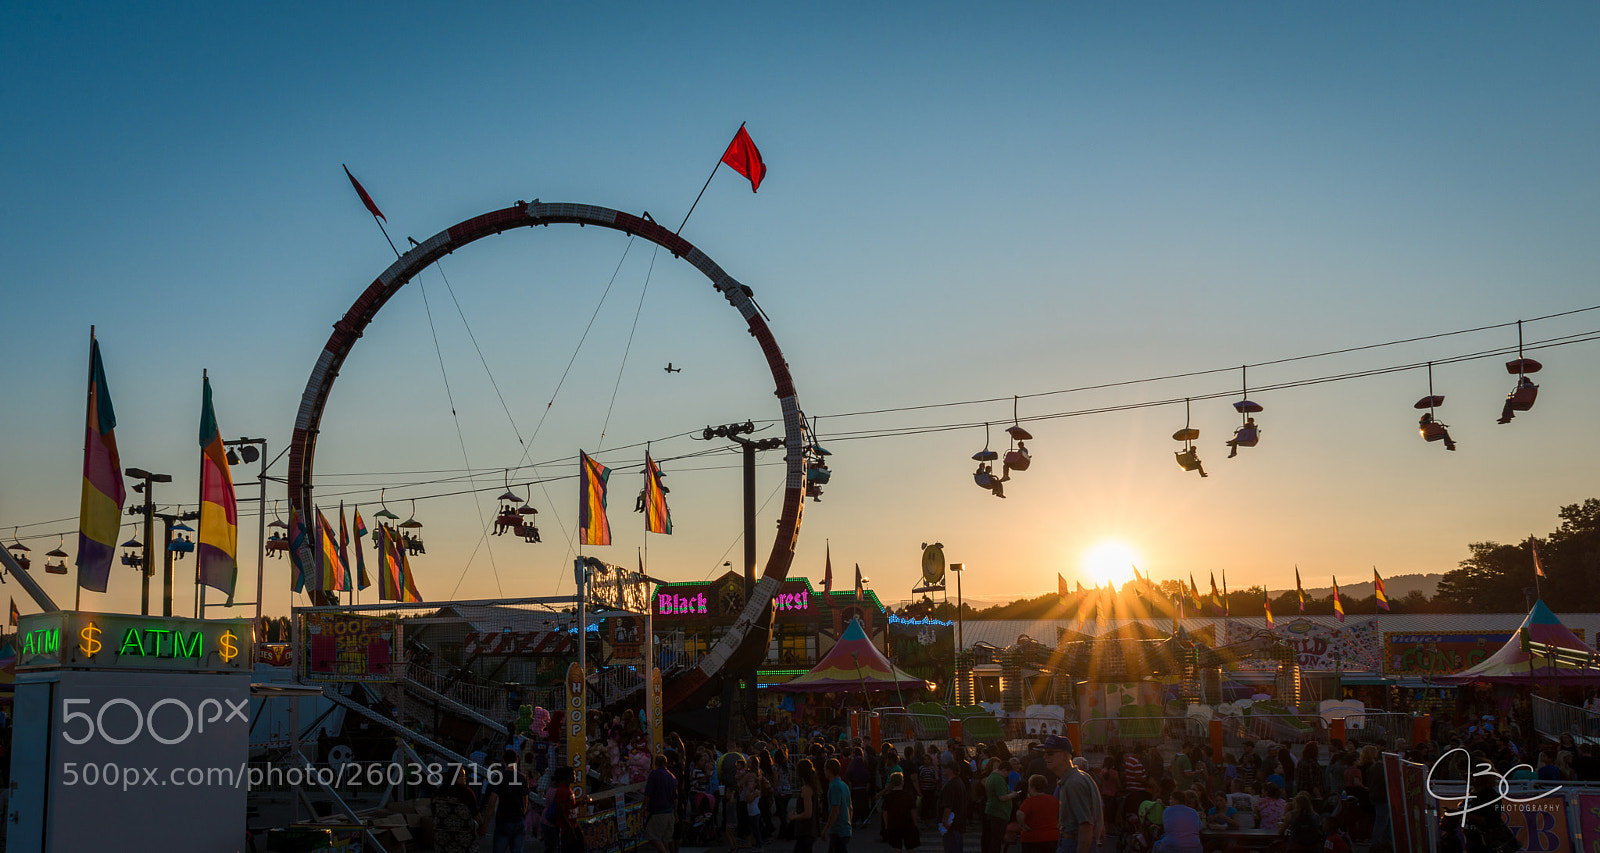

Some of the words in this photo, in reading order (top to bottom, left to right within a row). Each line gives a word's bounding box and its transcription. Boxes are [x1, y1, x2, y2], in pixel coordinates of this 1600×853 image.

[657, 592, 708, 615] Black
[321, 617, 371, 637] HOOP
[23, 628, 59, 655] ATM
[119, 627, 202, 658] ATM
[337, 632, 379, 650] SHOT
[1297, 655, 1320, 667] UN
[1402, 648, 1456, 671] FUN
[571, 682, 582, 737] HOOP
